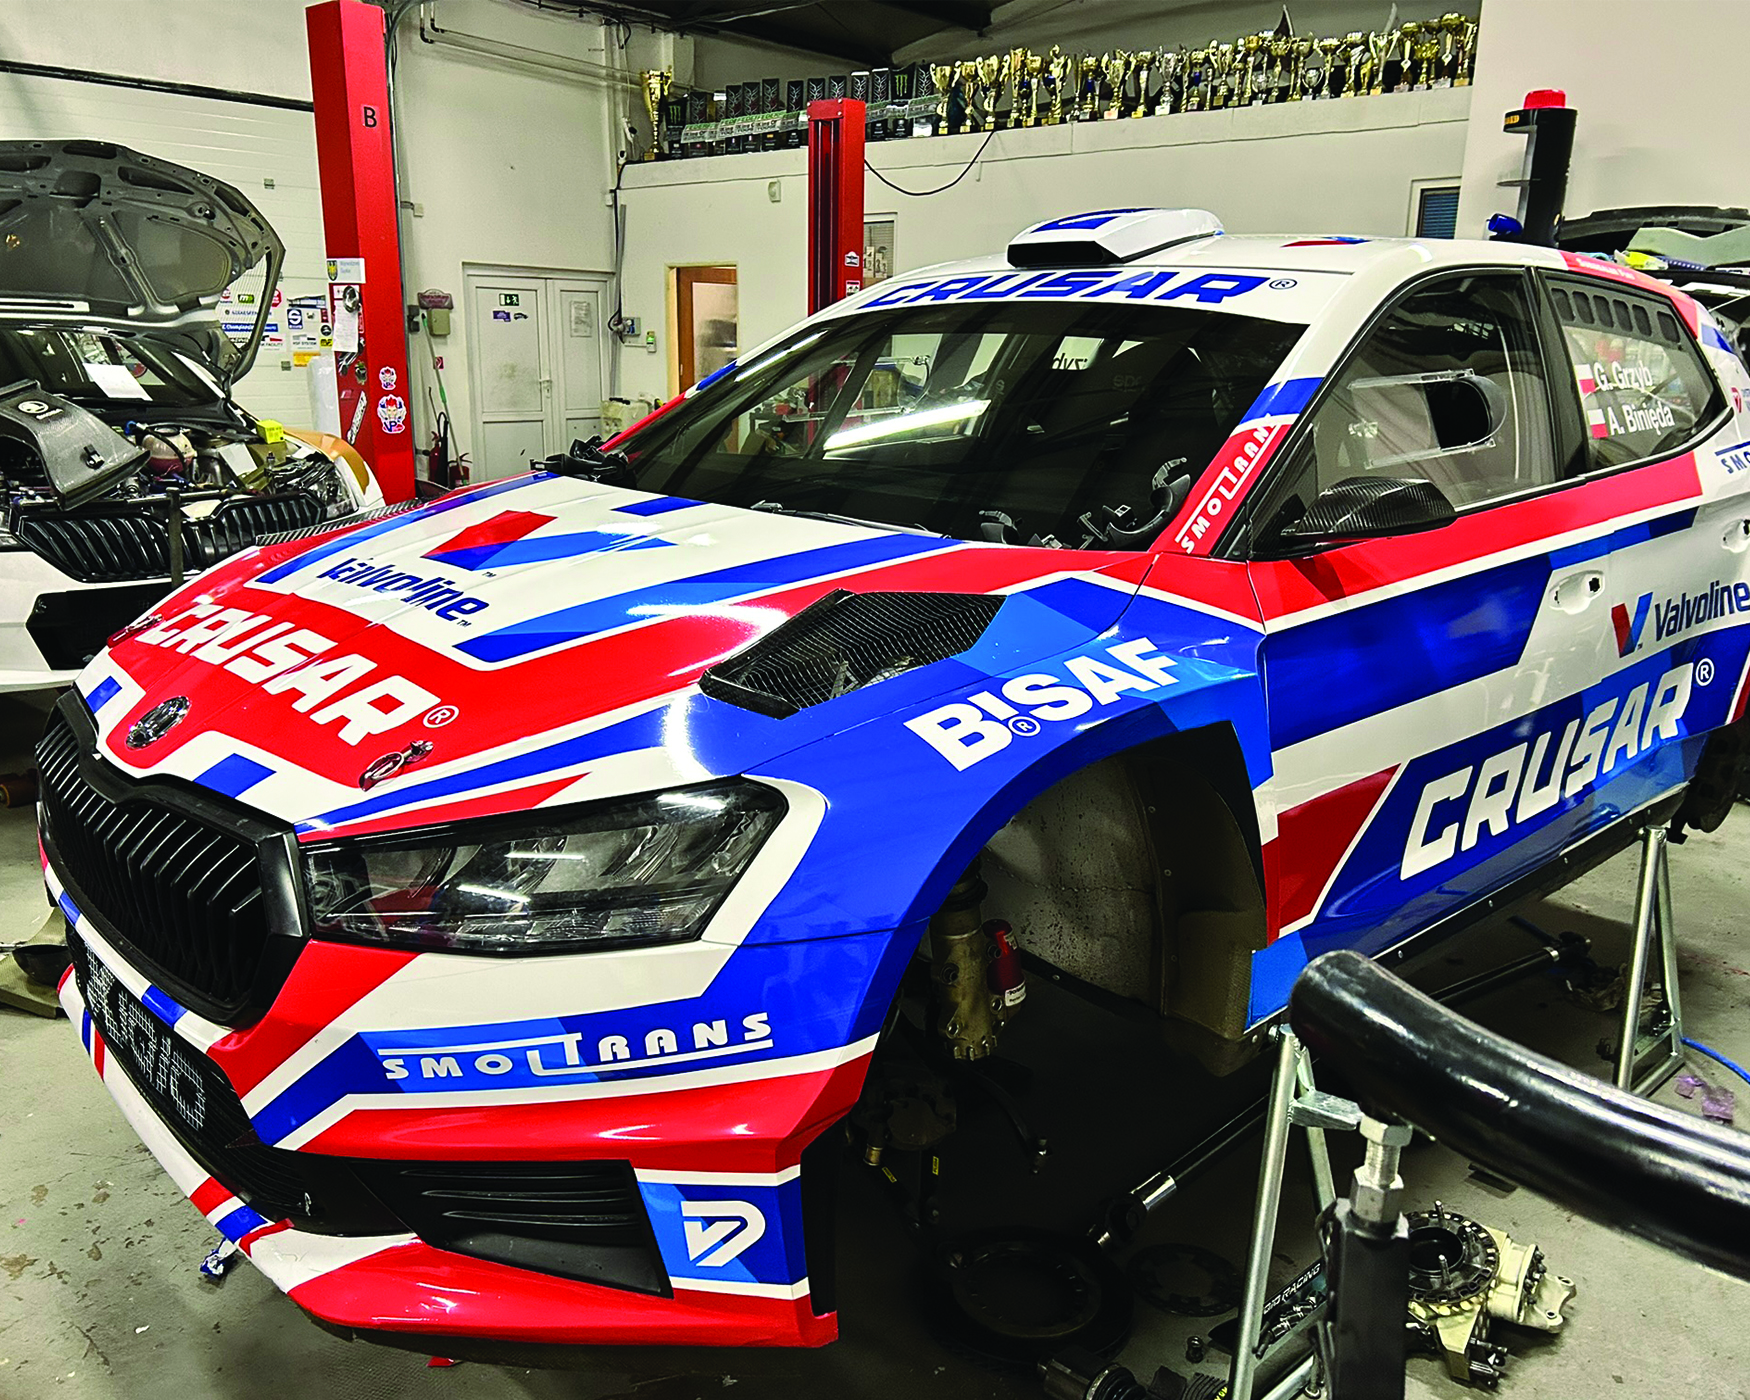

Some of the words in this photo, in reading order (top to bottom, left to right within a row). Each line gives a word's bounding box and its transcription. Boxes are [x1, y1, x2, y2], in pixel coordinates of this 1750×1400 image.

[363, 106, 377, 127] B
[1593, 361, 1613, 391] G.
[1611, 360, 1653, 393] Grzyb
[1607, 407, 1625, 436] A.
[1622, 401, 1675, 435] Binięda
[1655, 580, 1750, 642] Valvoline
[377, 1012, 774, 1079] SMOLTRANS
